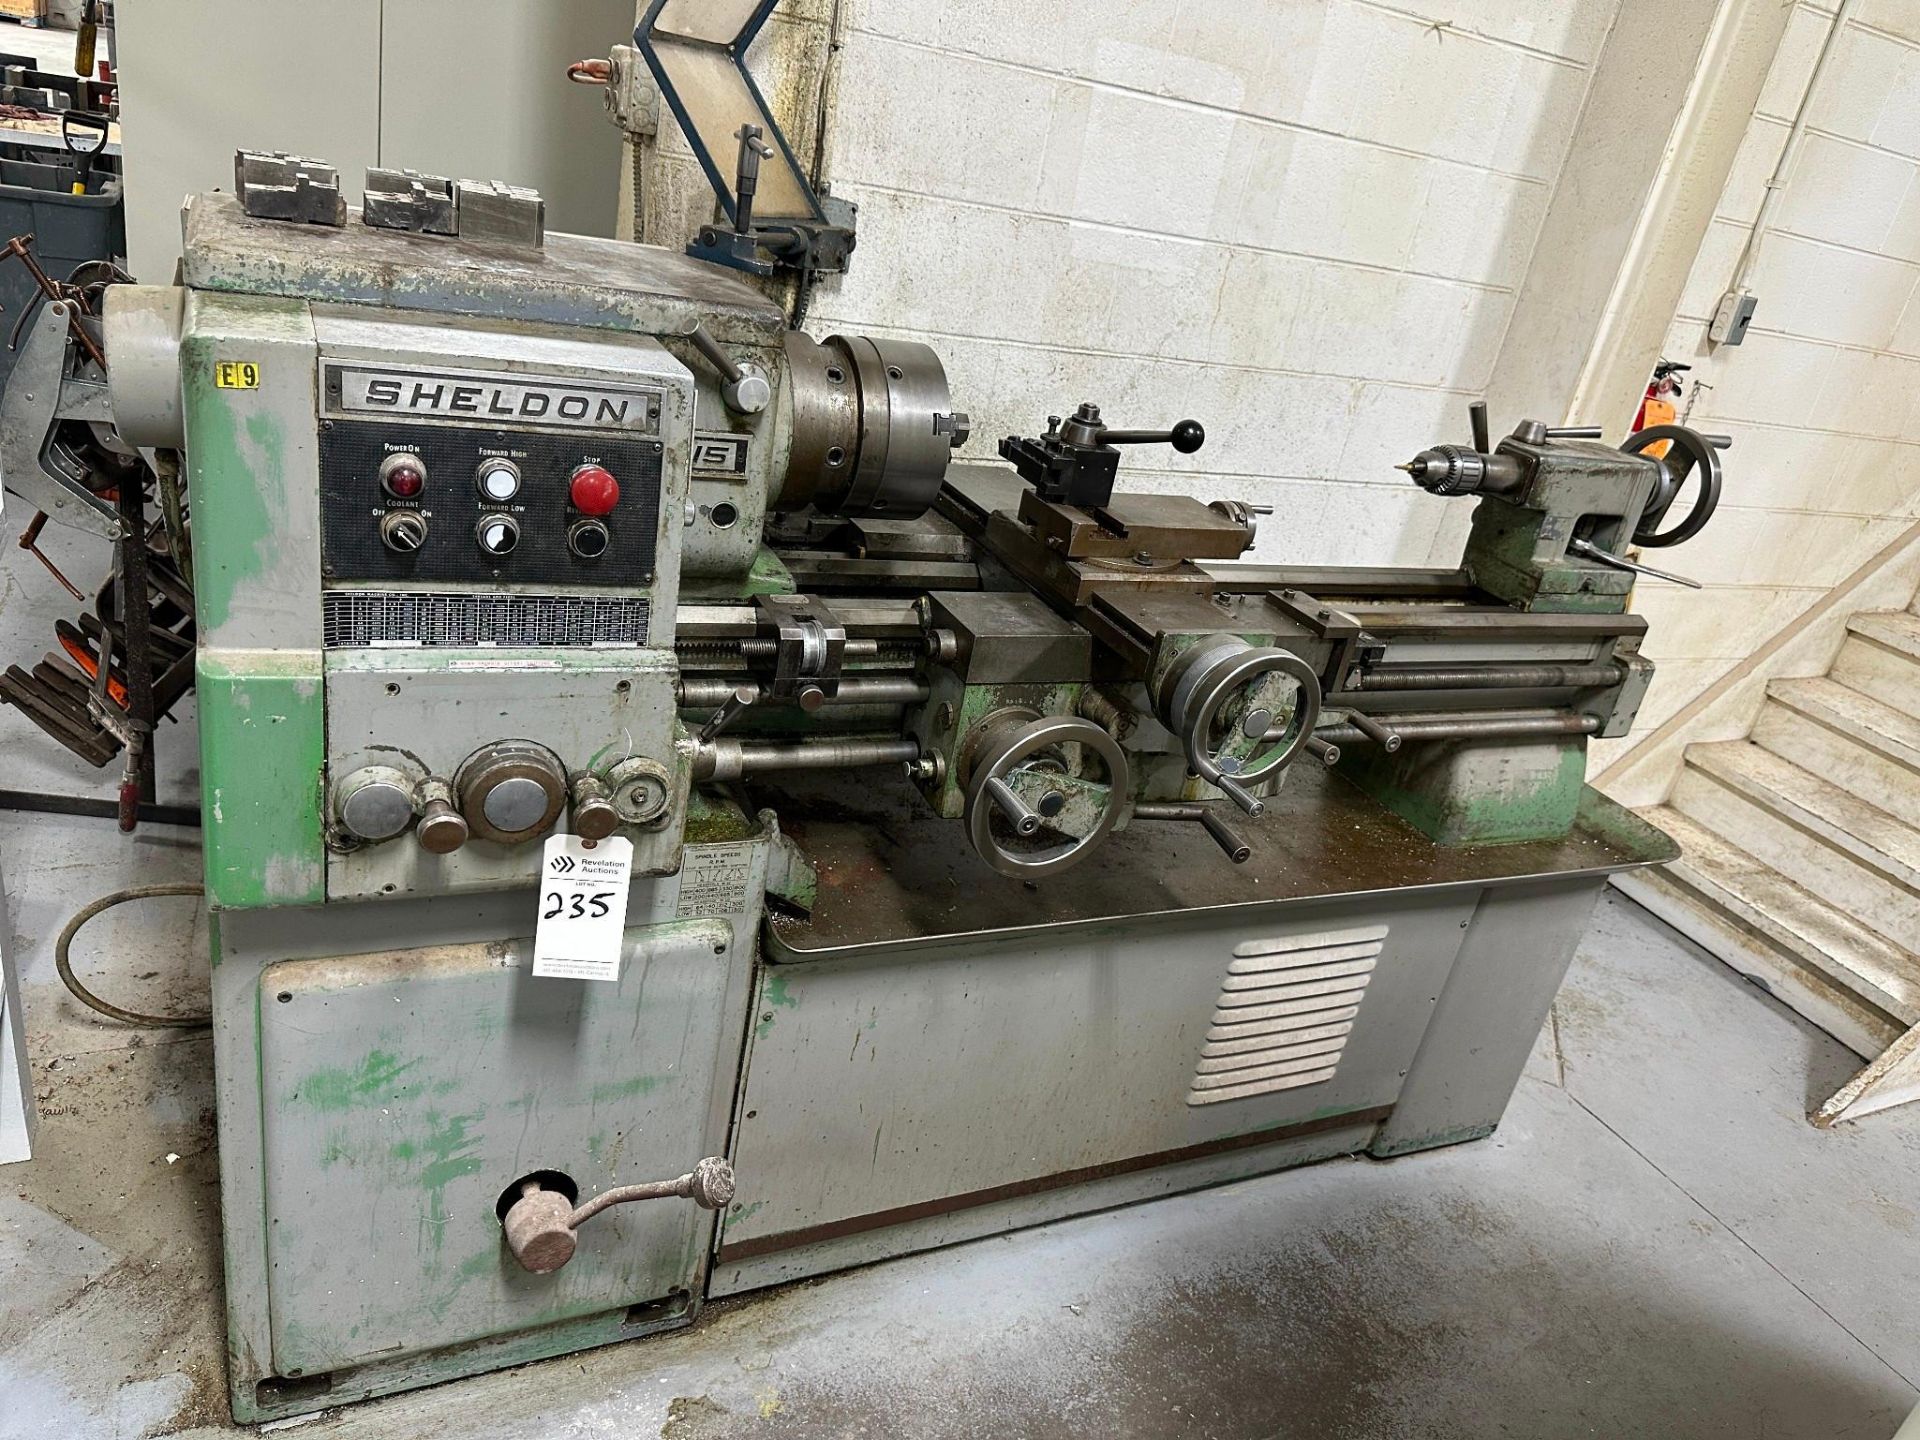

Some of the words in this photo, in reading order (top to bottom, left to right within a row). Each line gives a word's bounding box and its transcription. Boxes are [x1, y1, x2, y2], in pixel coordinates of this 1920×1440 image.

[366, 379, 629, 423] SHELDON
[479, 447, 509, 457] FORWARD
[510, 450, 528, 458] HIGH
[583, 456, 601, 464] STOP
[386, 499, 419, 508] COOLANT
[478, 502, 509, 512] FORWARD
[511, 504, 525, 512] LOW
[372, 508, 386, 517] OFF
[421, 510, 432, 518] ON
[581, 858, 625, 868] Revelation
[581, 867, 619, 875] Auctions
[543, 891, 616, 920] 235
